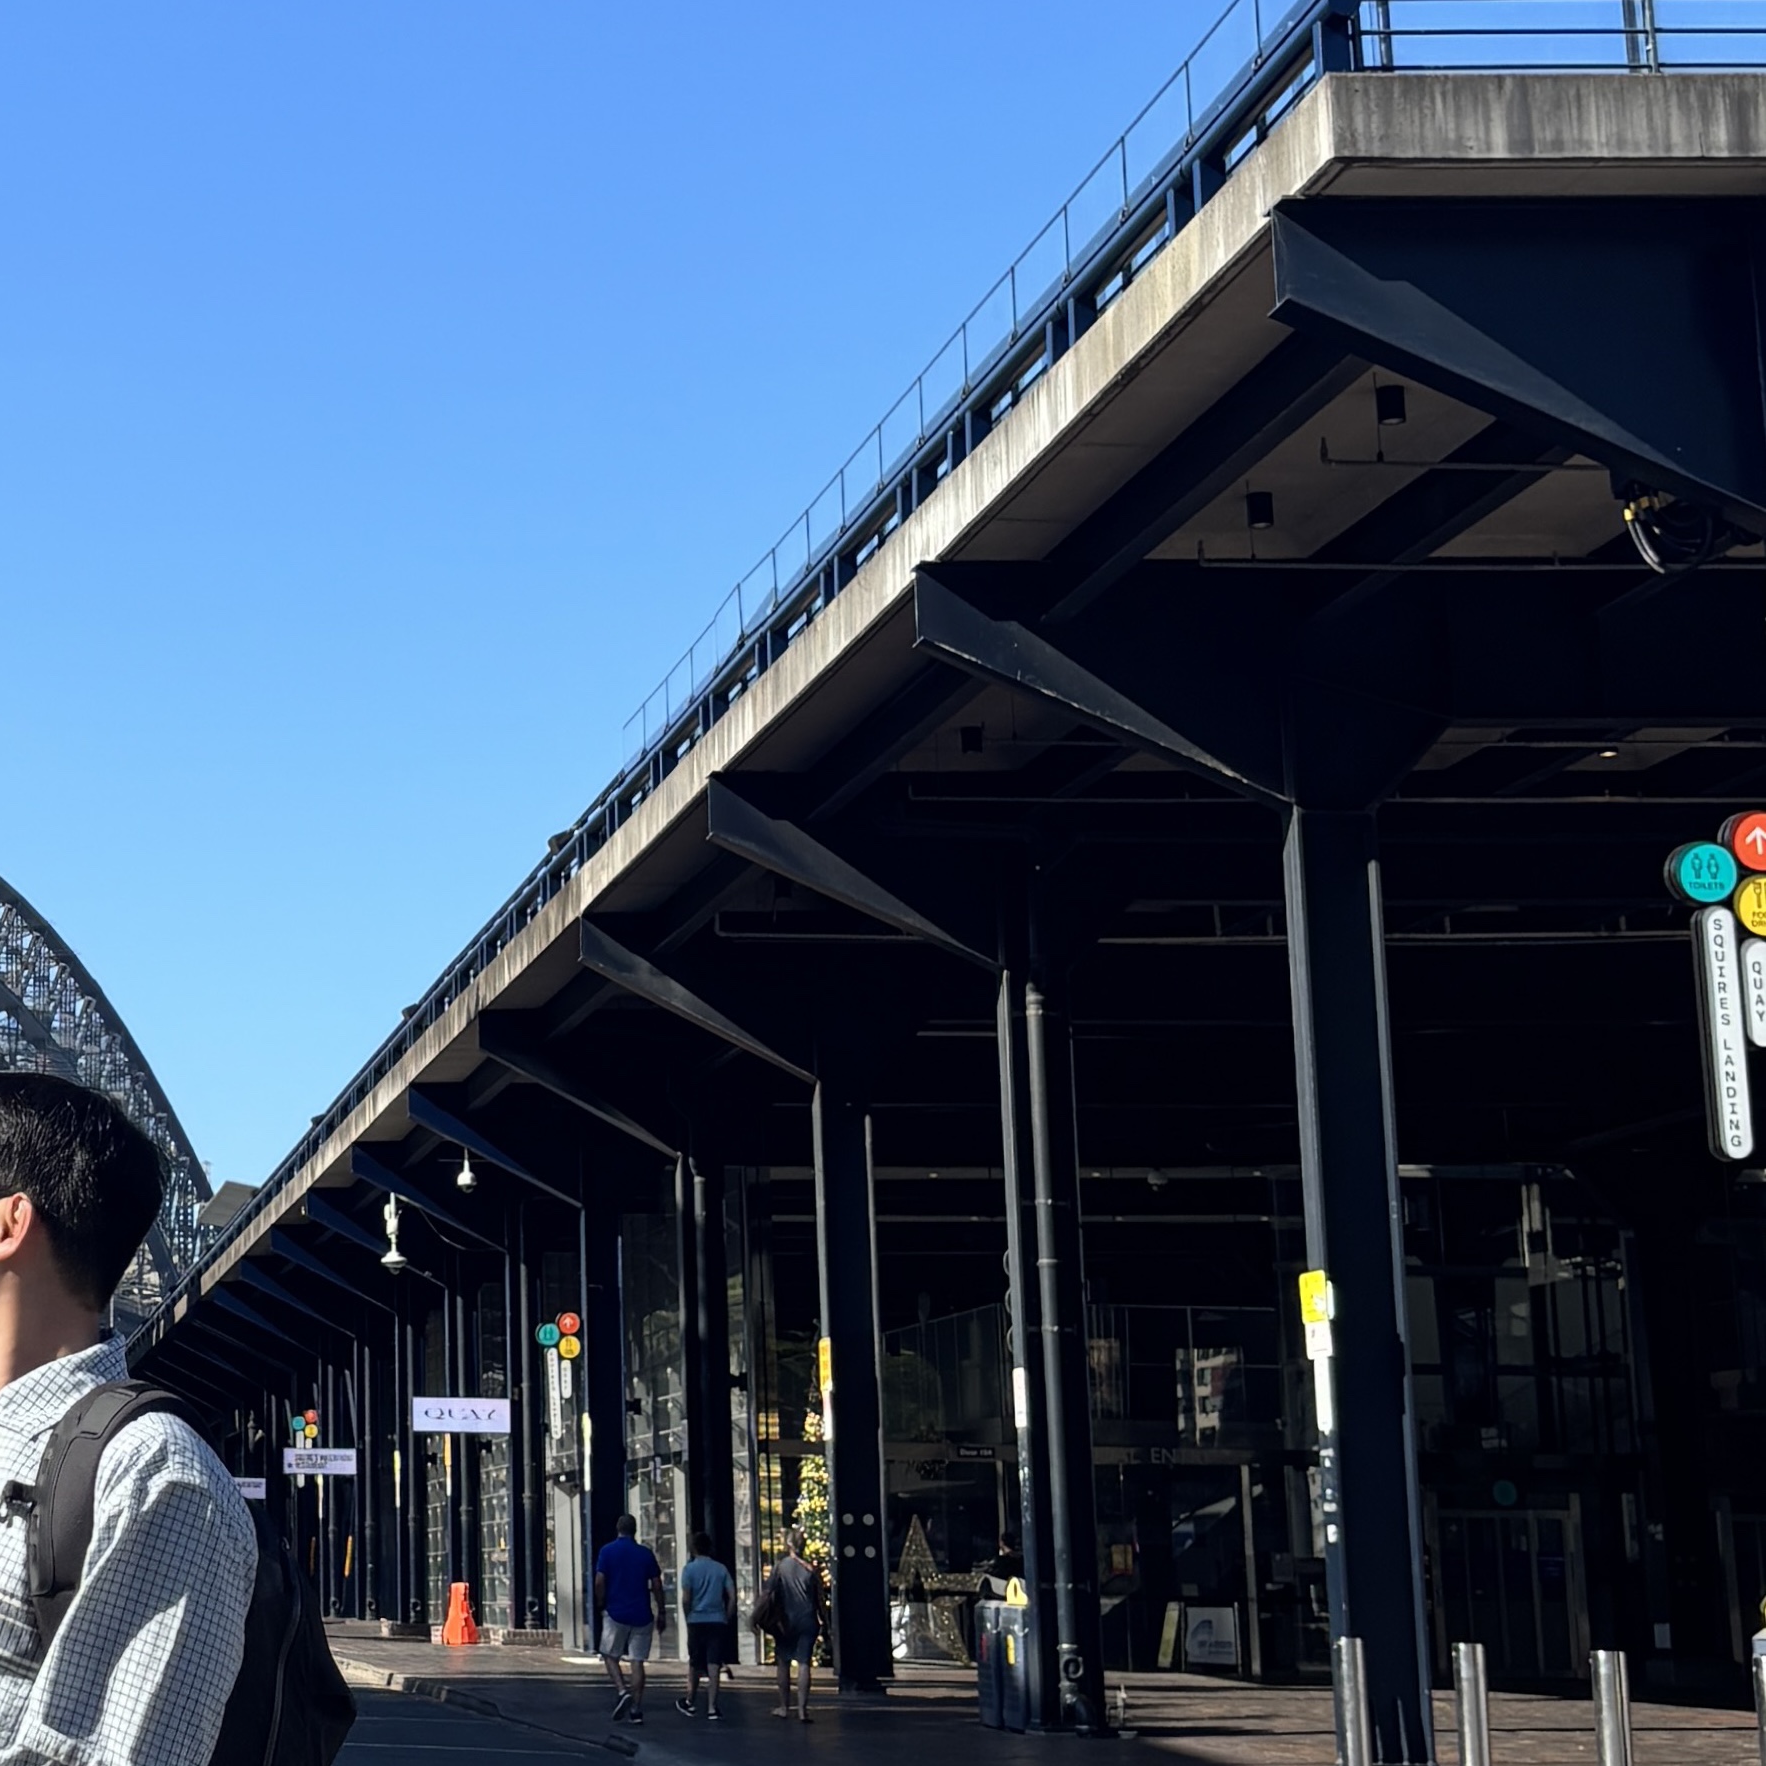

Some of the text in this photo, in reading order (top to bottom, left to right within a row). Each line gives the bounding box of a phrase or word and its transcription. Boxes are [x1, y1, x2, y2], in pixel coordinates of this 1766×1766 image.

[1689, 881, 1725, 891] TOILETS
[1751, 960, 1766, 1023] QUAY
[1713, 918, 1742, 1148] SQUIRES LANDING
